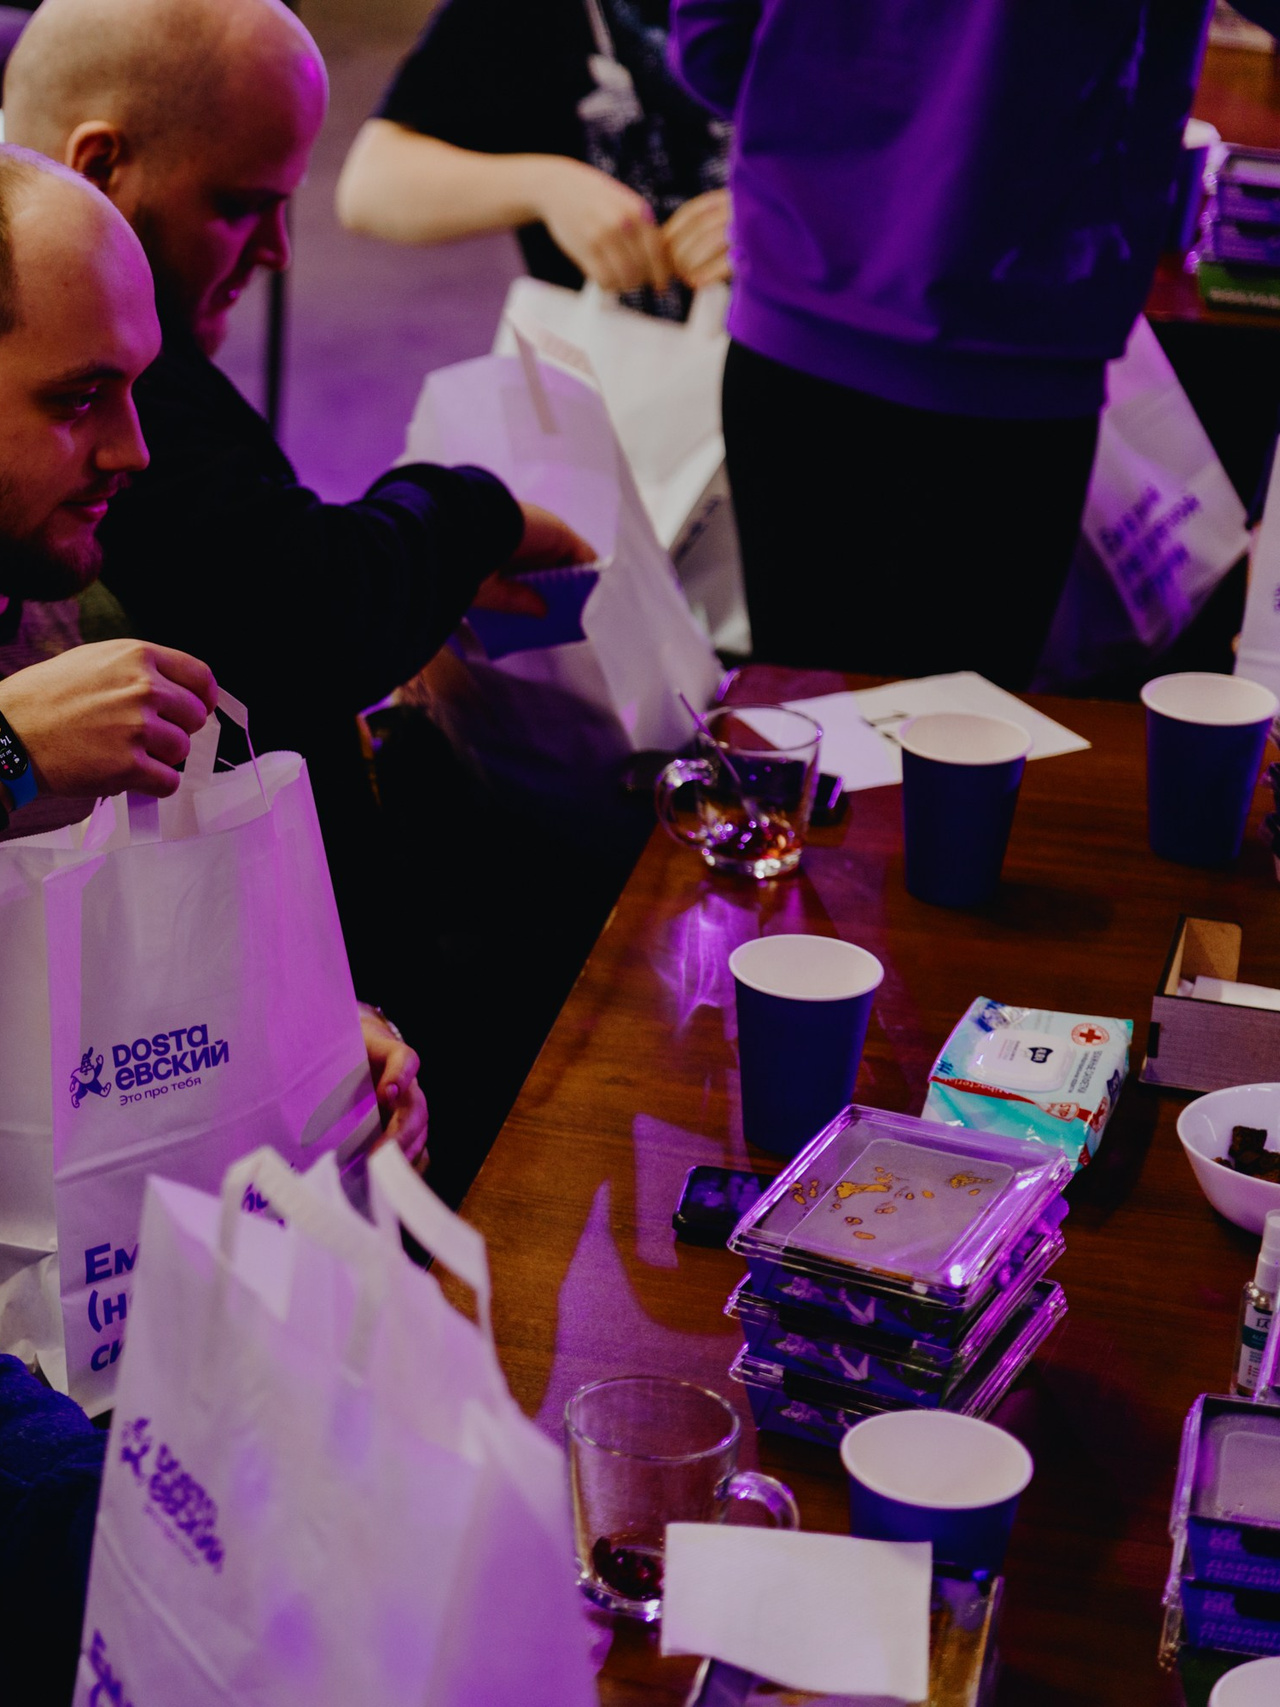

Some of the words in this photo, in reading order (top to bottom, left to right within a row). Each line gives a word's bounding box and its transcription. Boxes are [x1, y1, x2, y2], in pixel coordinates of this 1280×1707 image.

[119, 1092, 142, 1106] Это
[144, 1086, 168, 1099] про
[171, 1077, 201, 1091] тебя
